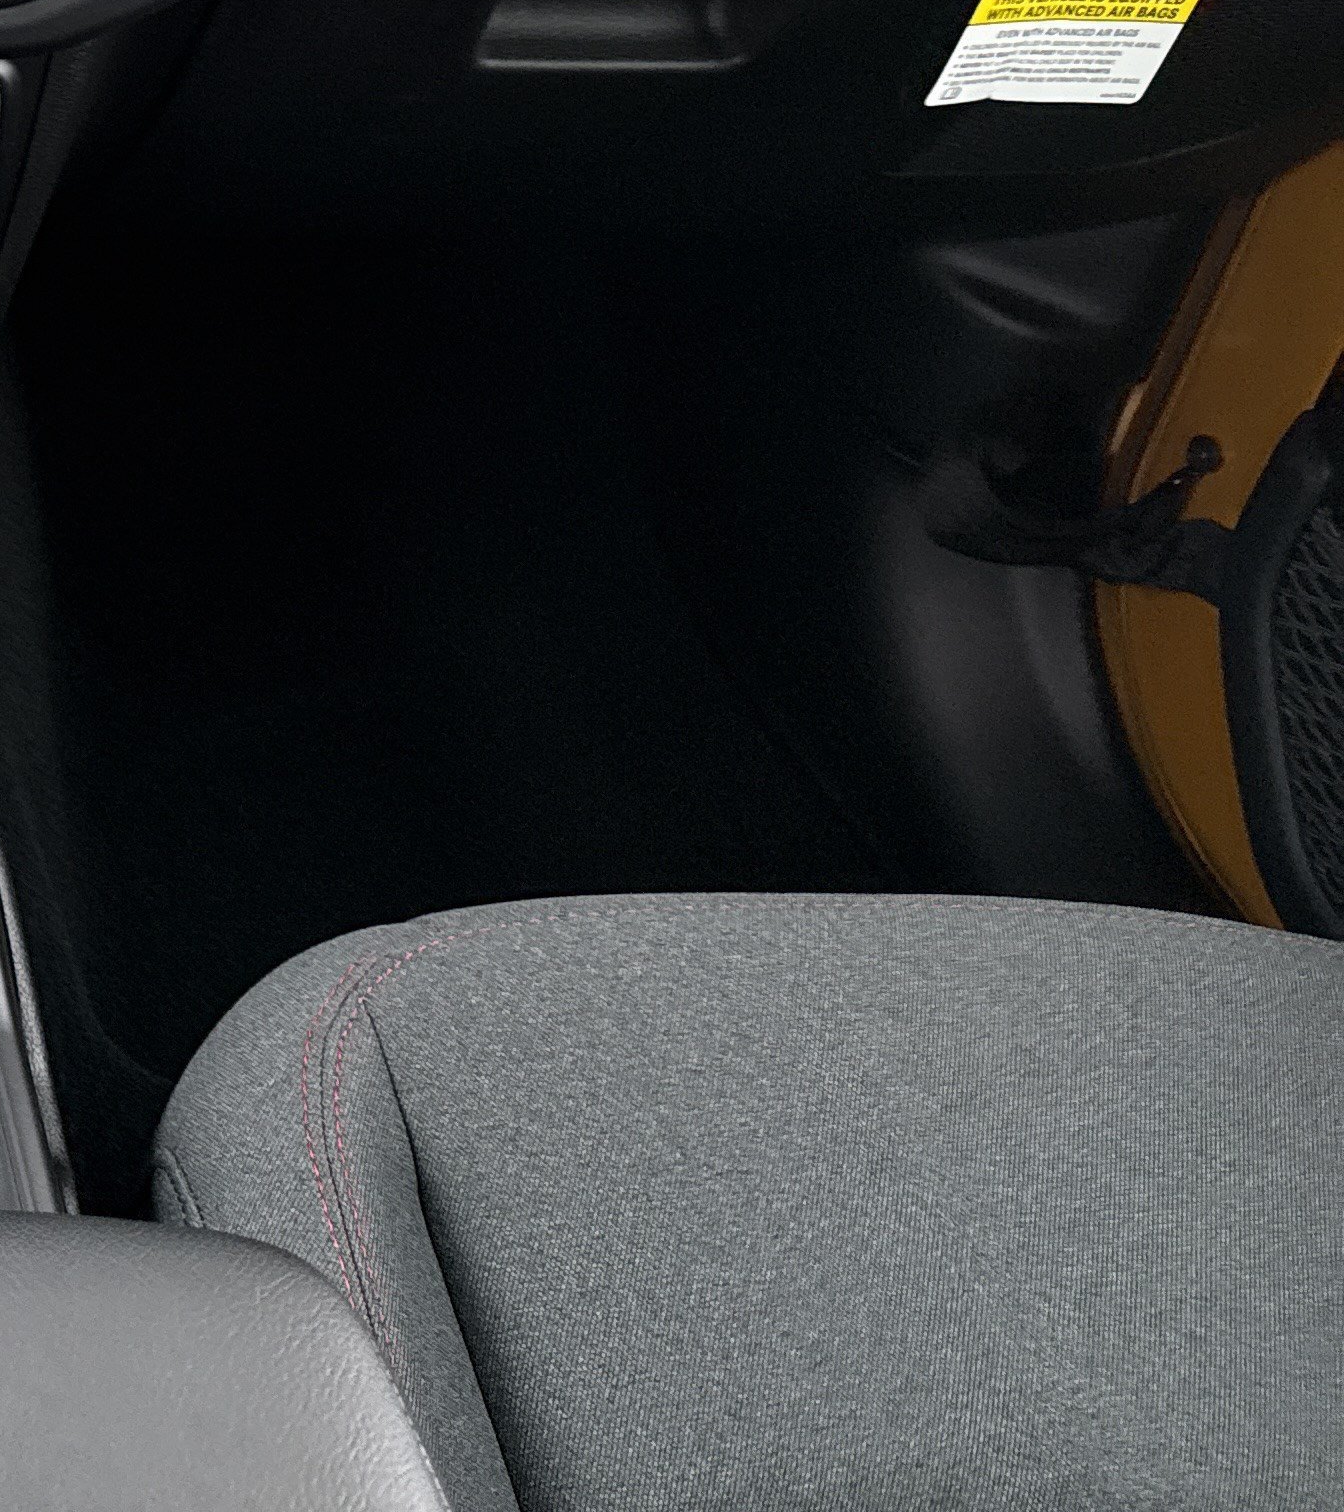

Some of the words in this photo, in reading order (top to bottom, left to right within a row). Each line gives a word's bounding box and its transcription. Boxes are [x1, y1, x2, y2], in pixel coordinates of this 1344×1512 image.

[986, 8, 1023, 21] WITH
[1024, 5, 1107, 19] ADVANCED
[1107, 6, 1135, 17] AIR
[1137, 7, 1180, 19] BAGS
